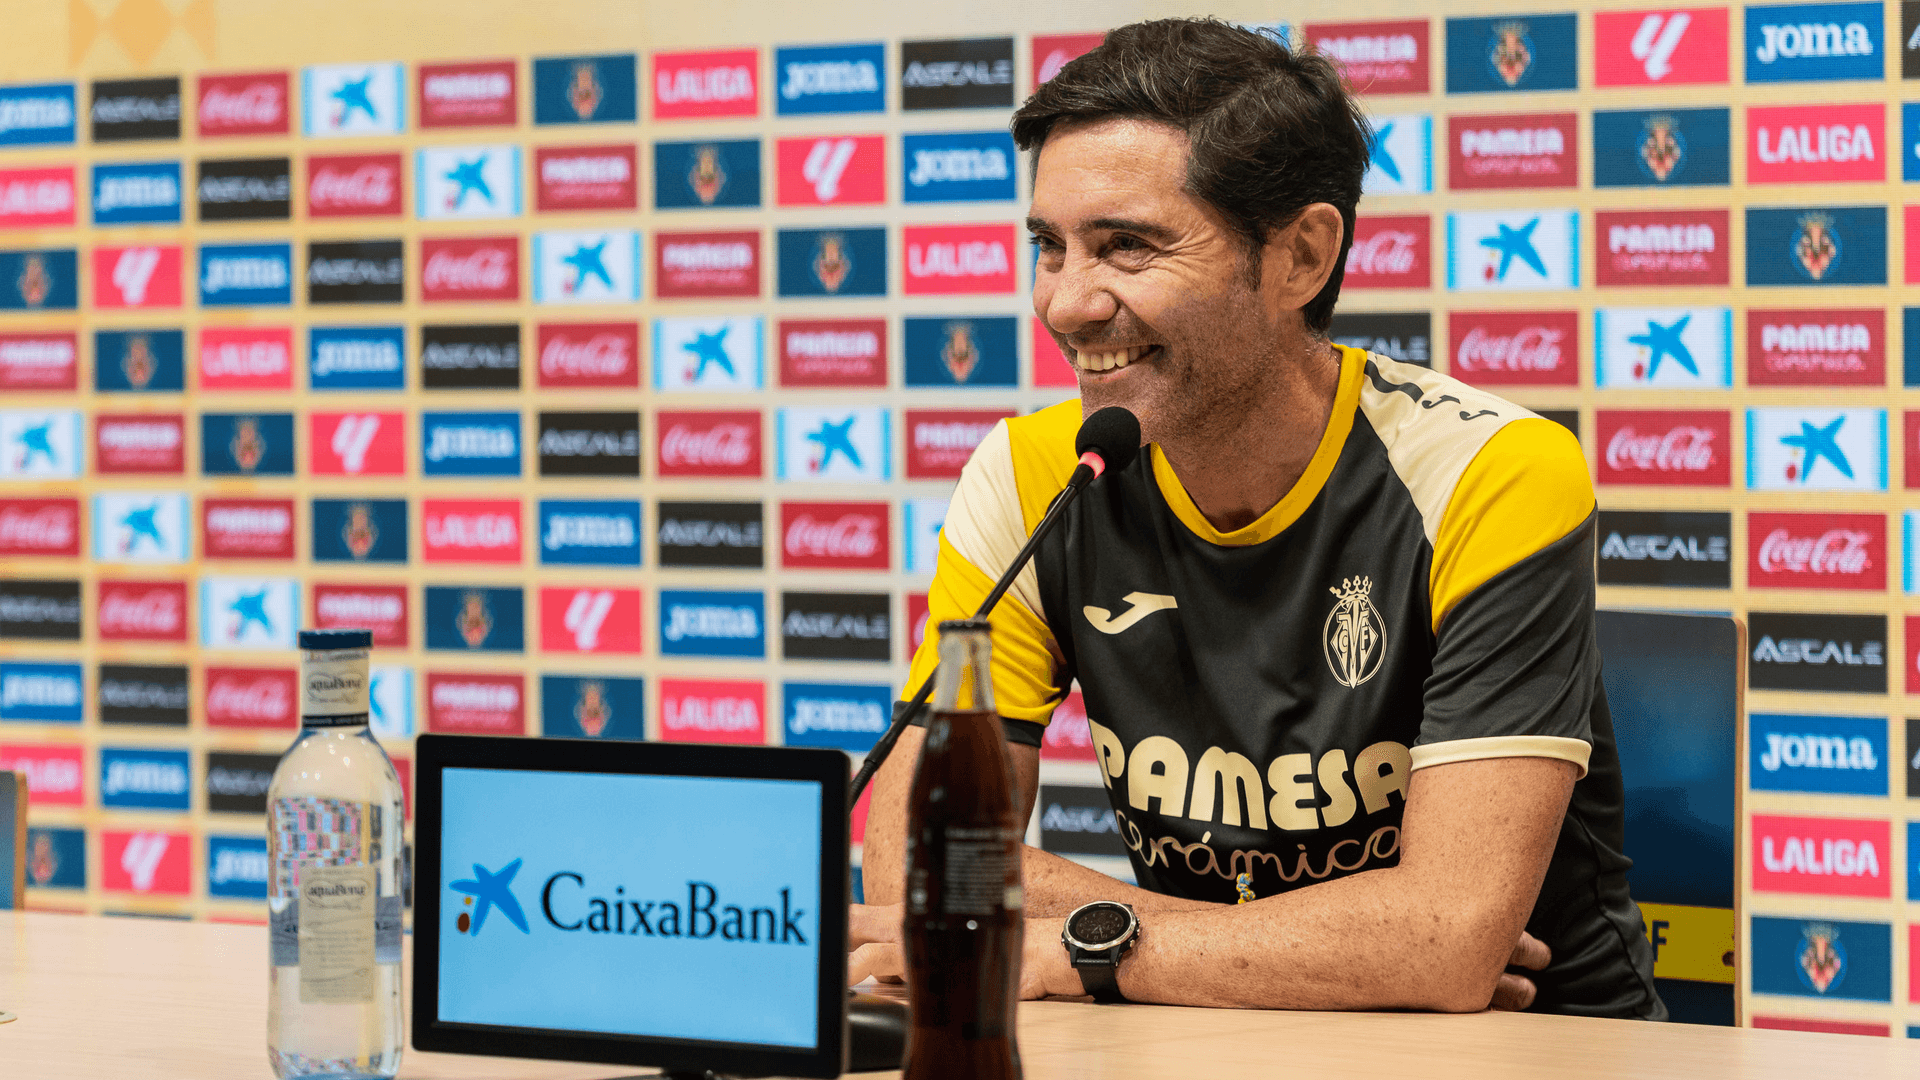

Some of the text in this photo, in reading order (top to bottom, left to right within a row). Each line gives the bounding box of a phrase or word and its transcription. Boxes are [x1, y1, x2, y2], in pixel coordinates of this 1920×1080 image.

[1461, 128, 1564, 157] PAMESA
[1758, 125, 1874, 163] LALIGA
[1609, 224, 1714, 253] PAMESA
[1456, 325, 1562, 371] Coca-Cola
[1761, 324, 1870, 352] PAMESA
[1604, 424, 1714, 470] Coca-Cola
[1600, 533, 1726, 561] ASCALE
[1757, 527, 1869, 574] Coca-Cola
[1752, 636, 1882, 665] ASCALE
[1088, 717, 1410, 831] PAMESA
[1763, 837, 1879, 877] LALIGA
[541, 872, 808, 944] CaixaBank
